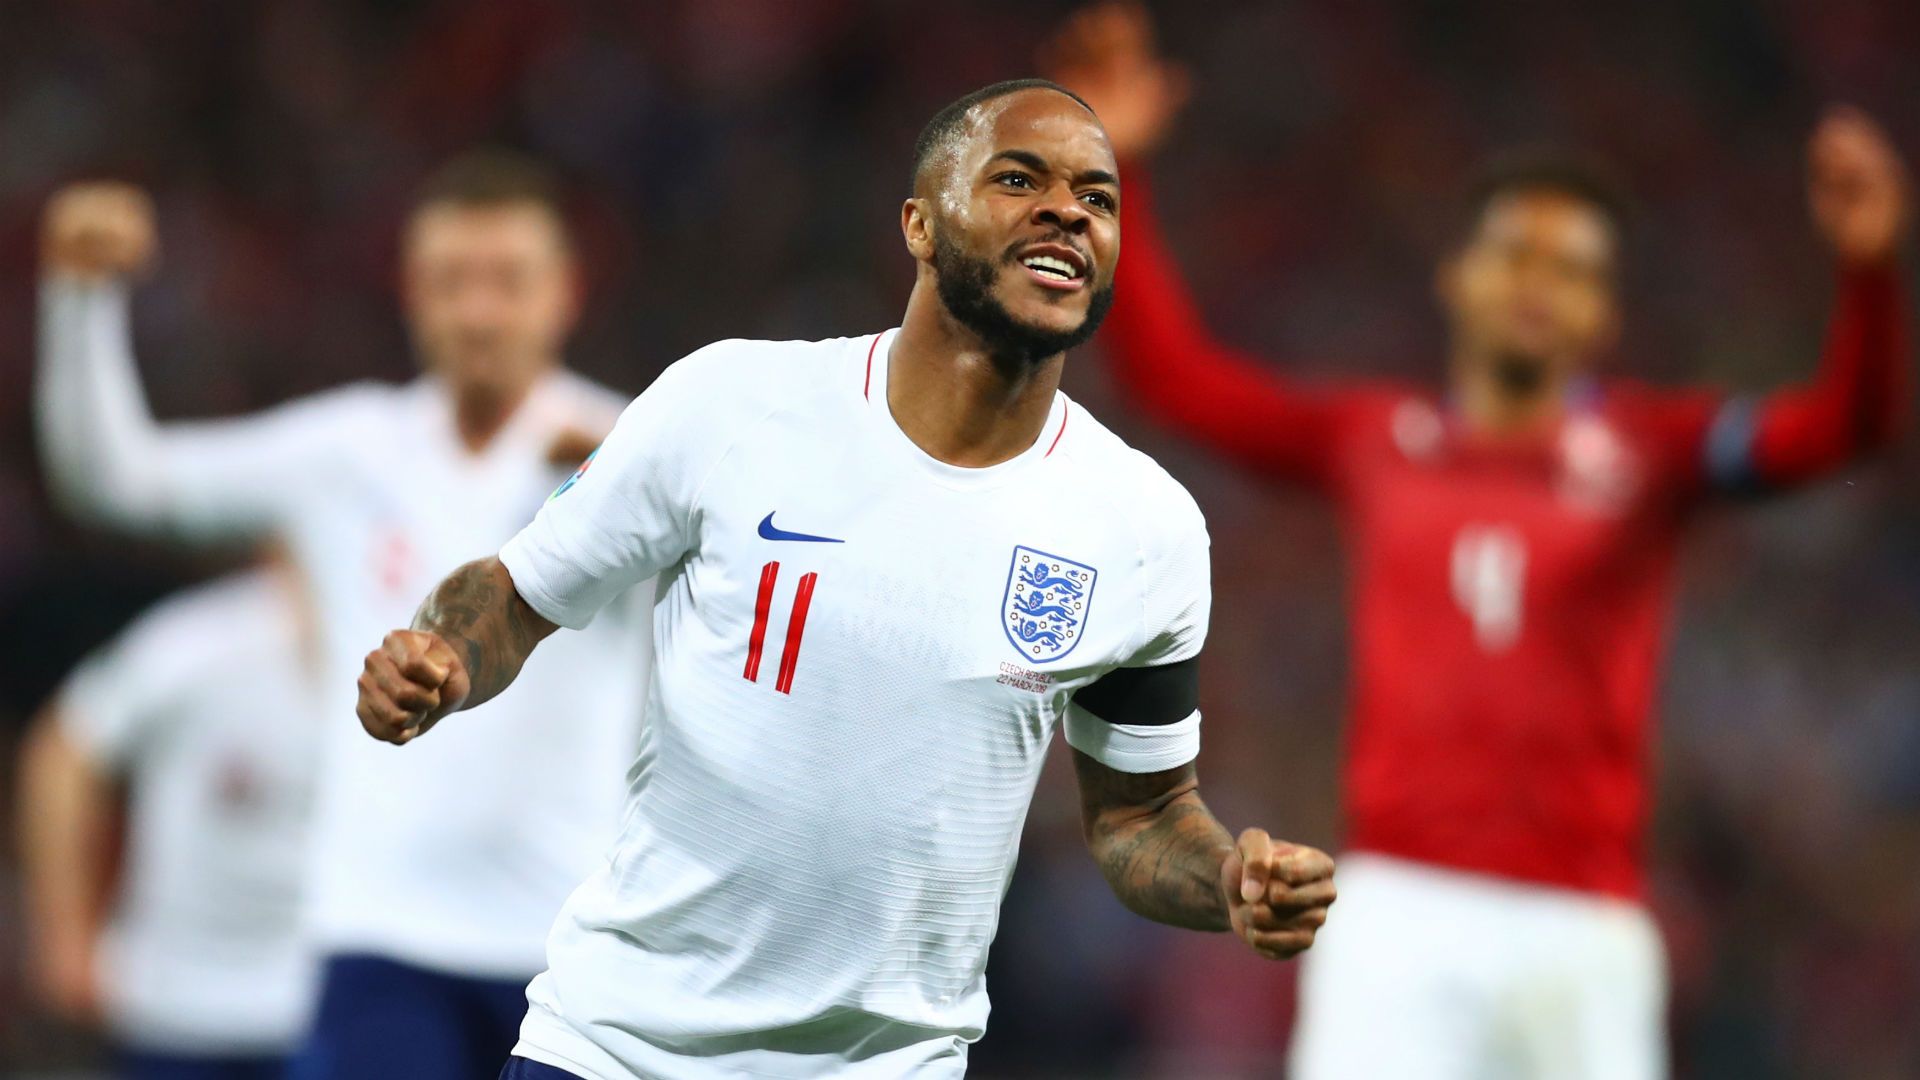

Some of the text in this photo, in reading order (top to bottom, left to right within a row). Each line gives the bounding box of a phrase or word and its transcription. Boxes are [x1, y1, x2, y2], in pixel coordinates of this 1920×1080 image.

[743, 561, 818, 695] 11
[999, 661, 1025, 677] CZECH
[996, 673, 1008, 684] 22
[1008, 677, 1033, 691] MARCH
